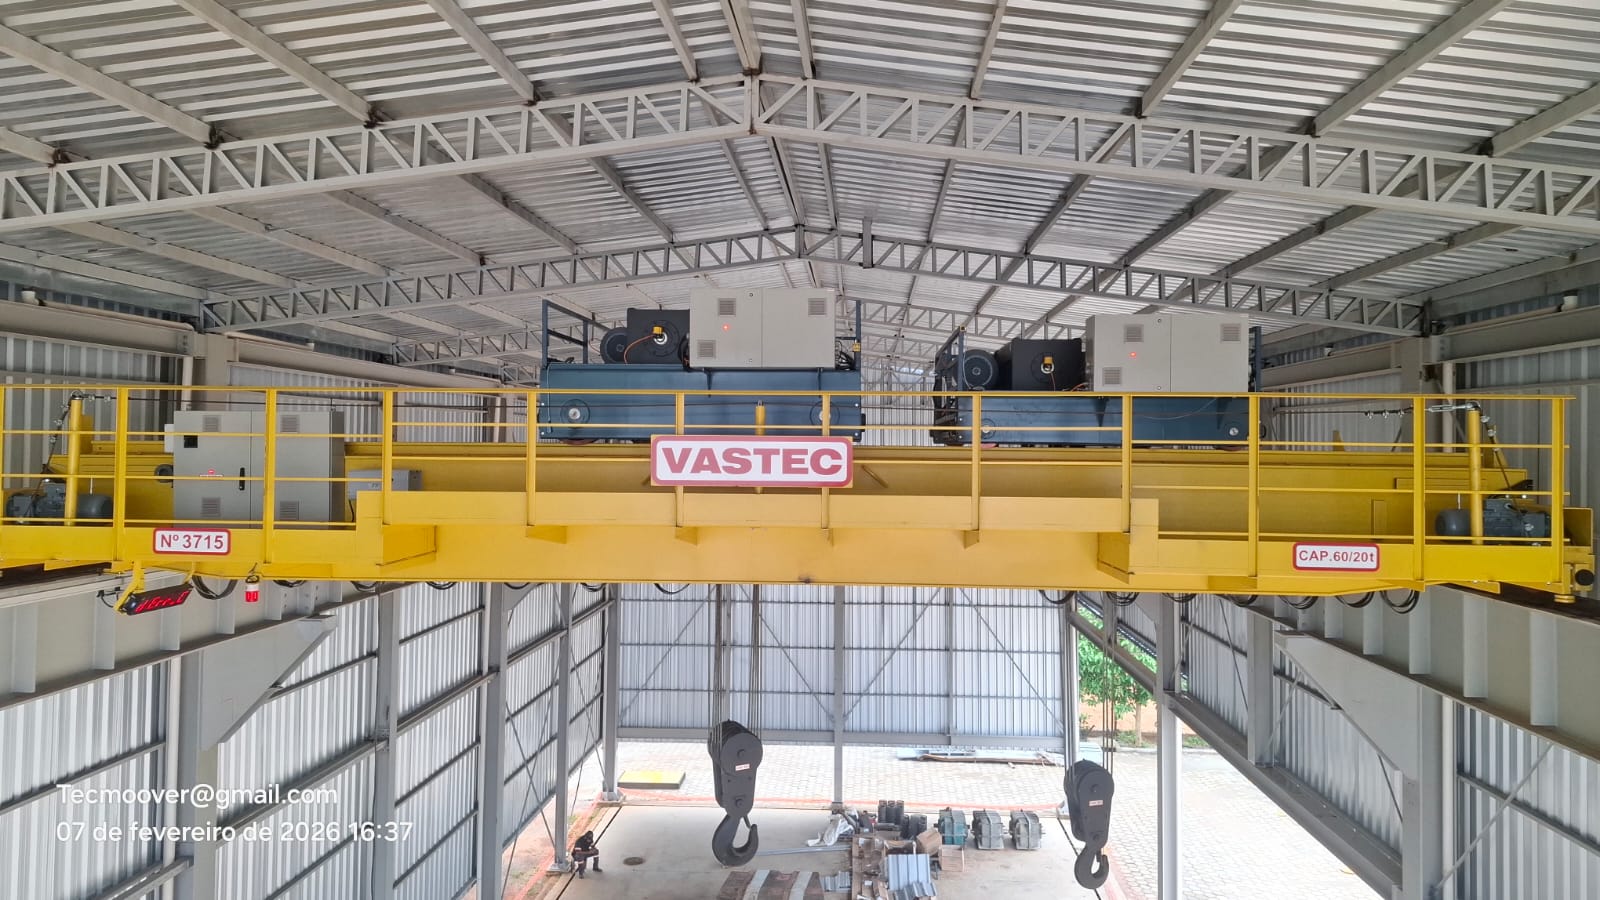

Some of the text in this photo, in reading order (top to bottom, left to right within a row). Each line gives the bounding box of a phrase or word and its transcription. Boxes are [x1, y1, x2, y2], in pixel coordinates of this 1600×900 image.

[662, 447, 842, 475] VASTEC
[182, 534, 223, 549] 3715
[1299, 550, 1374, 562] CAP.60/20t
